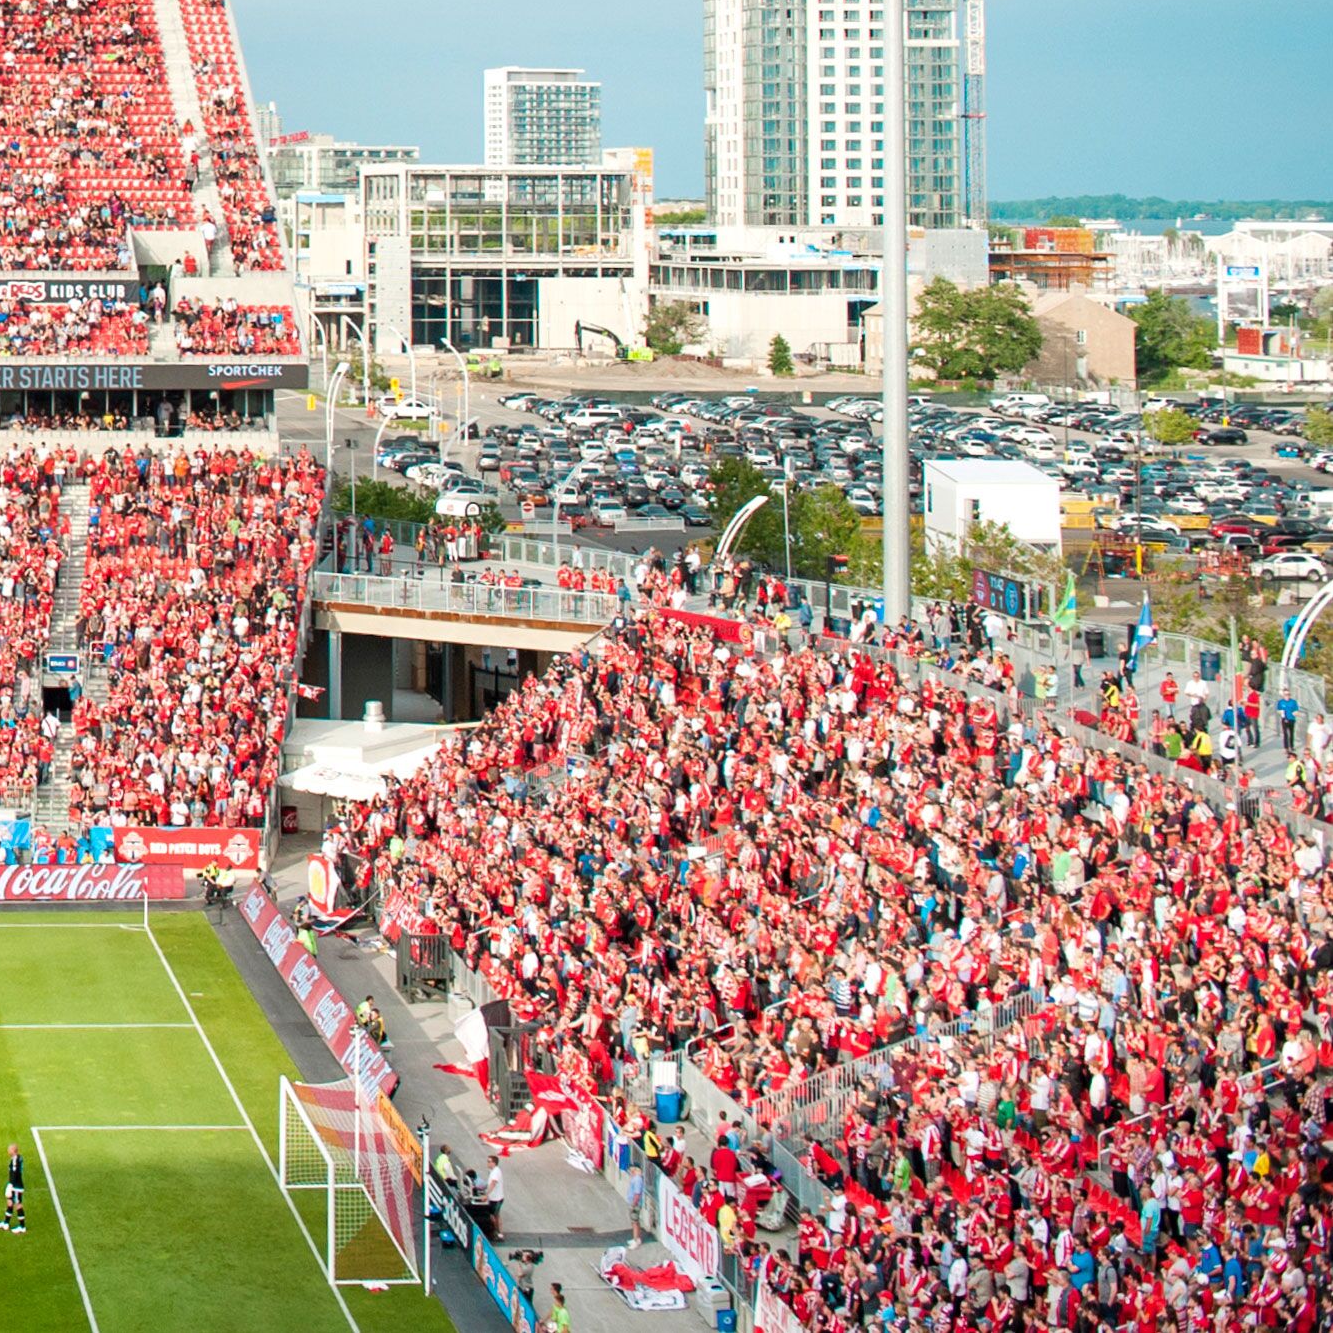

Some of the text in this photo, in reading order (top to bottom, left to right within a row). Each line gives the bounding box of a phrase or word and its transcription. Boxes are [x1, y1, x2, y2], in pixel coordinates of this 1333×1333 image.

[10, 282, 43, 297] REDS
[50, 285, 83, 297] KIDS
[90, 284, 124, 297] CLUB
[19, 367, 89, 388] STARTS
[95, 367, 143, 388] HERE
